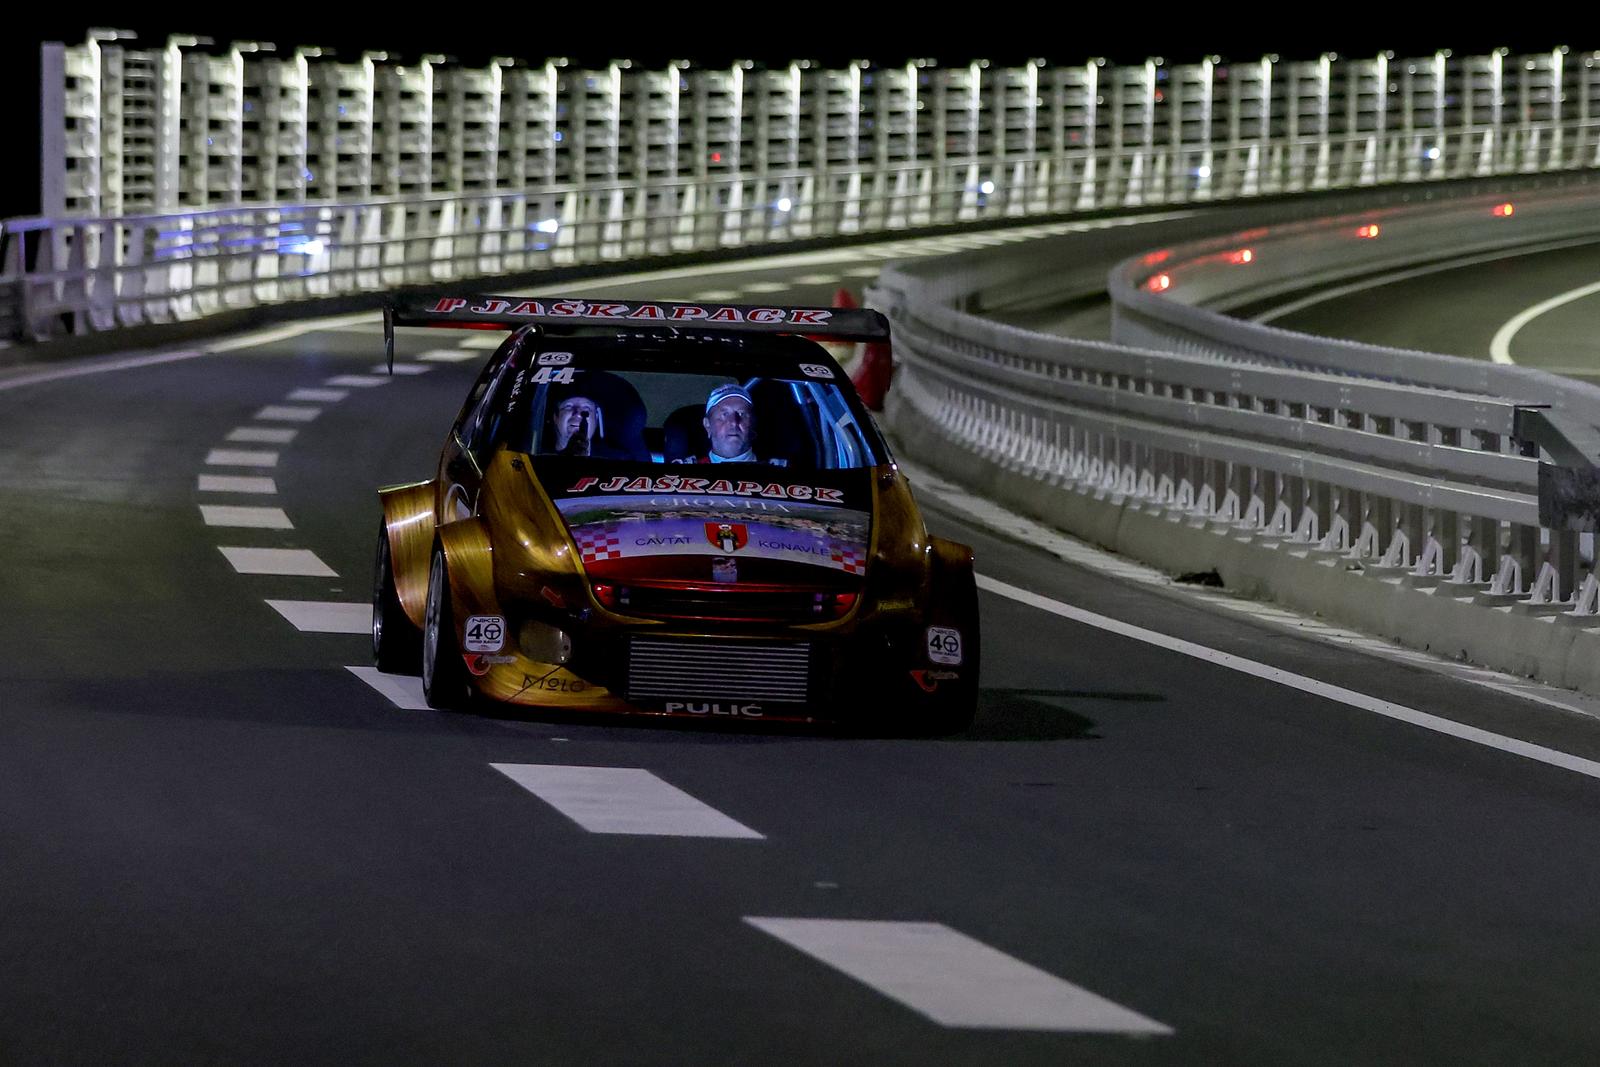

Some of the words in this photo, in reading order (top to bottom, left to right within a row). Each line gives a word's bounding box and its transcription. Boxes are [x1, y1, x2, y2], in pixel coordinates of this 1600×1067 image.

[470, 299, 832, 325] JAŠKAPACK
[531, 367, 575, 384] 44
[599, 475, 845, 503] JAŠKAPACK
[635, 536, 692, 546] CAVTAT
[758, 539, 832, 556] KONAVLE
[665, 702, 764, 717] PULIĆ
